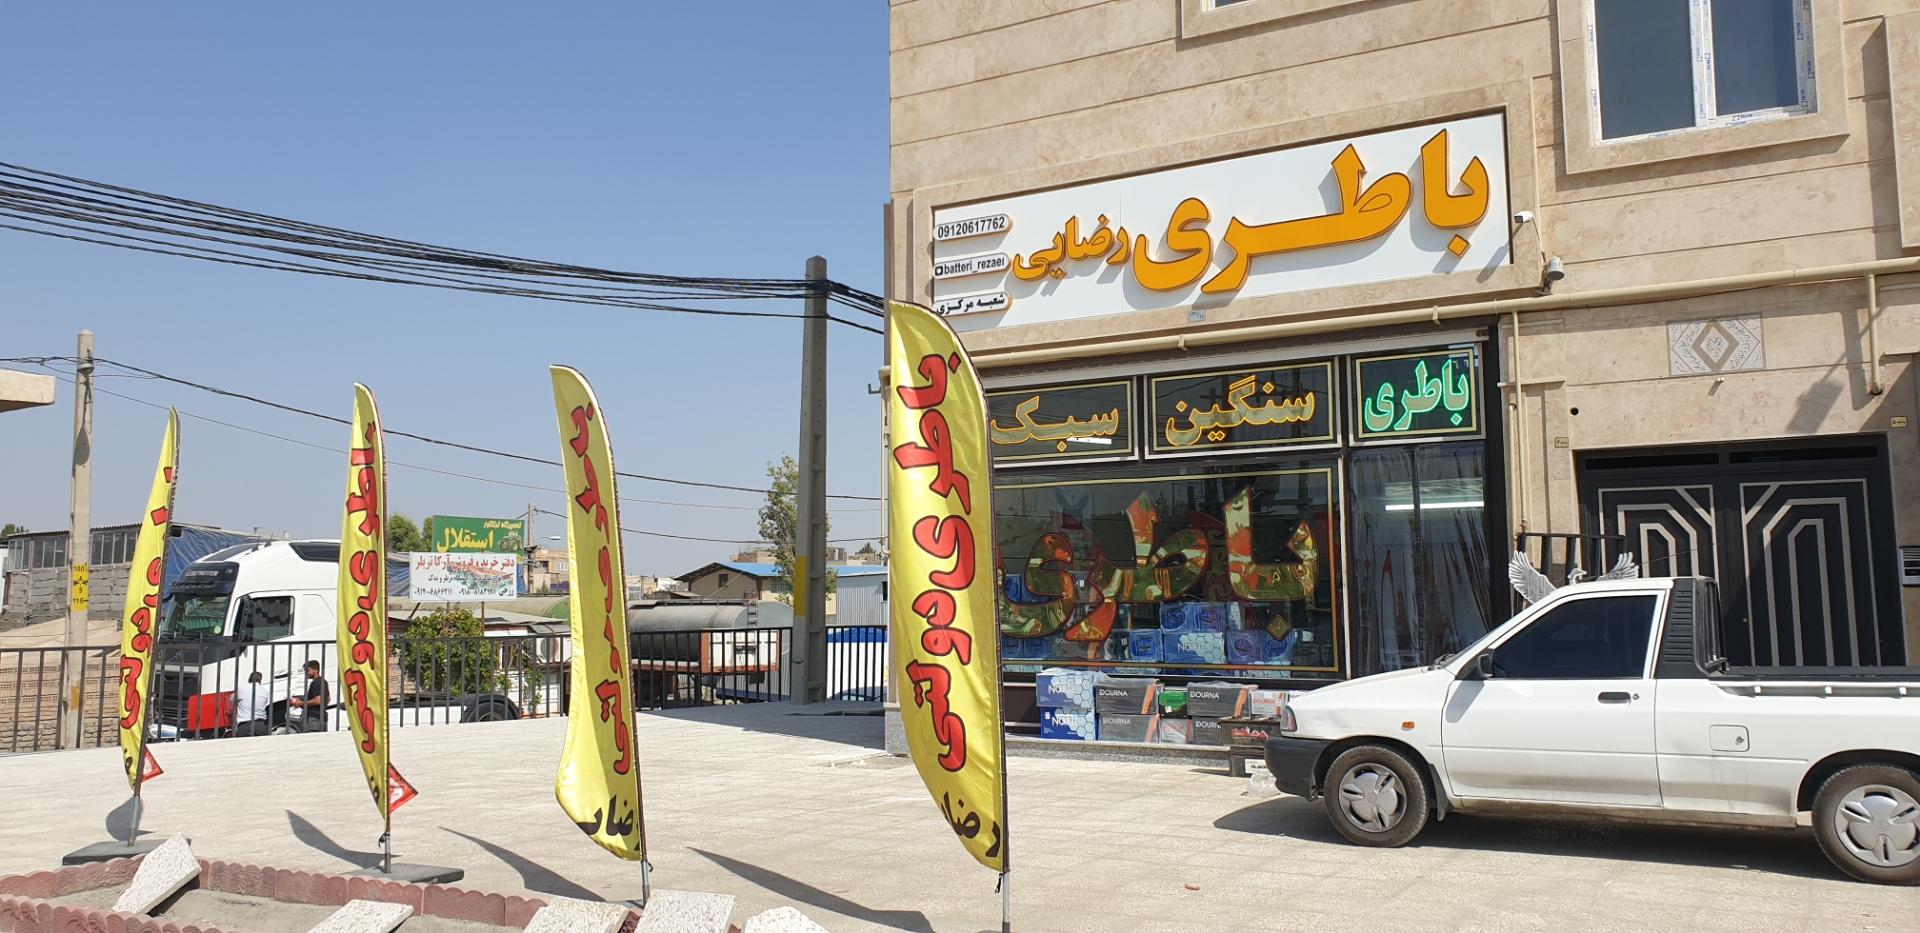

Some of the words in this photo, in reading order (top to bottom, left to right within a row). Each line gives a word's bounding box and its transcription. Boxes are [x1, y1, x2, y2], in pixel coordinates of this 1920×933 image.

[937, 216, 1005, 239] 09120617762
[1131, 127, 1490, 294] باطری
[1012, 213, 1130, 282] رضایی
[936, 298, 975, 315] مرکزی
[976, 293, 1005, 309] شعبه
[990, 395, 1120, 453] سبک
[1164, 374, 1316, 447] سنگین
[1363, 359, 1470, 432] باطری
[893, 351, 976, 590] باطری
[436, 527, 494, 553] استقلال
[480, 556, 499, 570] خرید
[501, 555, 515, 571] دفتر
[995, 488, 1320, 642] باطری
[568, 401, 613, 615] باطری
[594, 613, 632, 776] دولتی
[907, 588, 973, 773] دولتی
[1189, 690, 1220, 700] DOURNA
[1195, 720, 1222, 729] DOURN
[941, 791, 1001, 858] رضا
